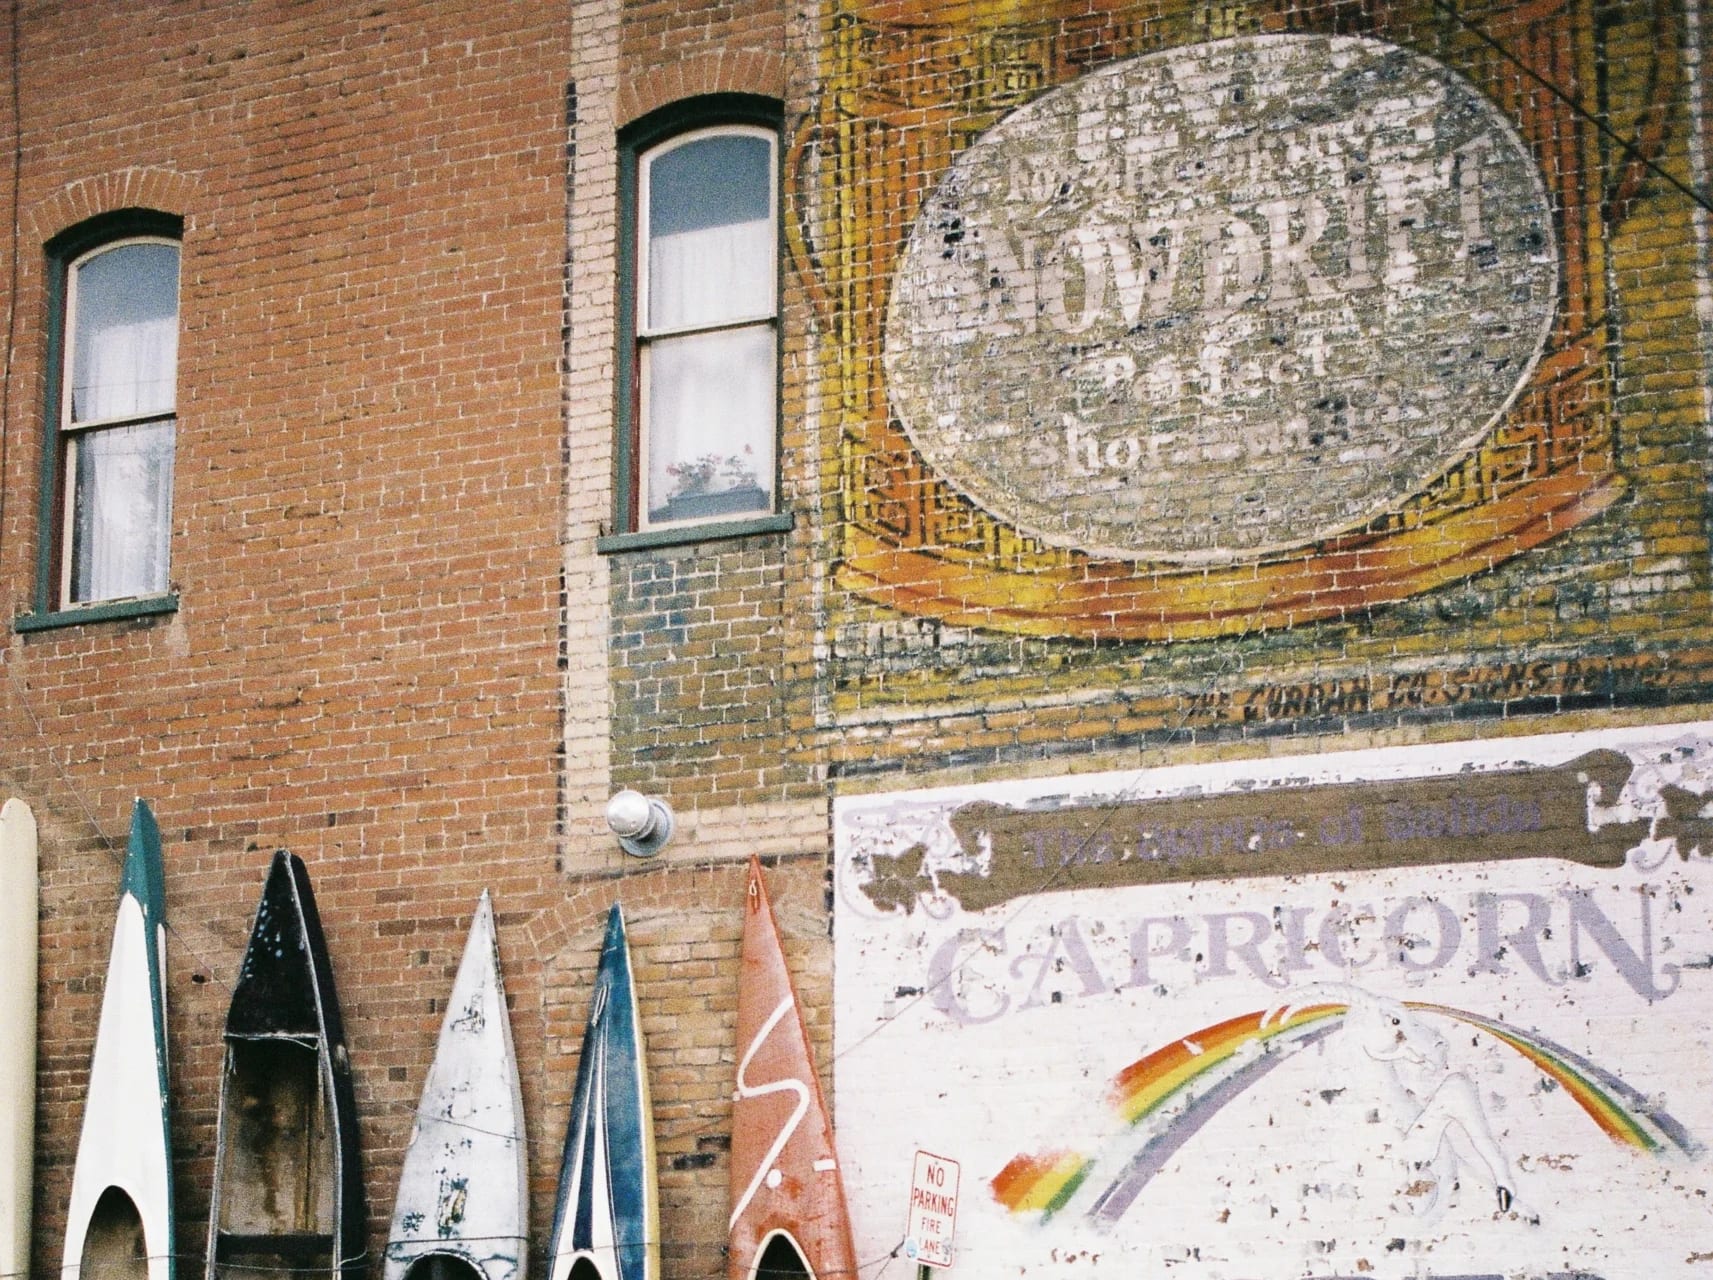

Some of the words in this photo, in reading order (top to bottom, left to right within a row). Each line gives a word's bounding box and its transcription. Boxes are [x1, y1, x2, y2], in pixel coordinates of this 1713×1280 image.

[1318, 801, 1364, 845] of
[926, 885, 1681, 1025] CAPRICORN
[926, 1164, 945, 1187] NO
[913, 1187, 955, 1217] PARKING
[921, 1217, 942, 1234] FIRE
